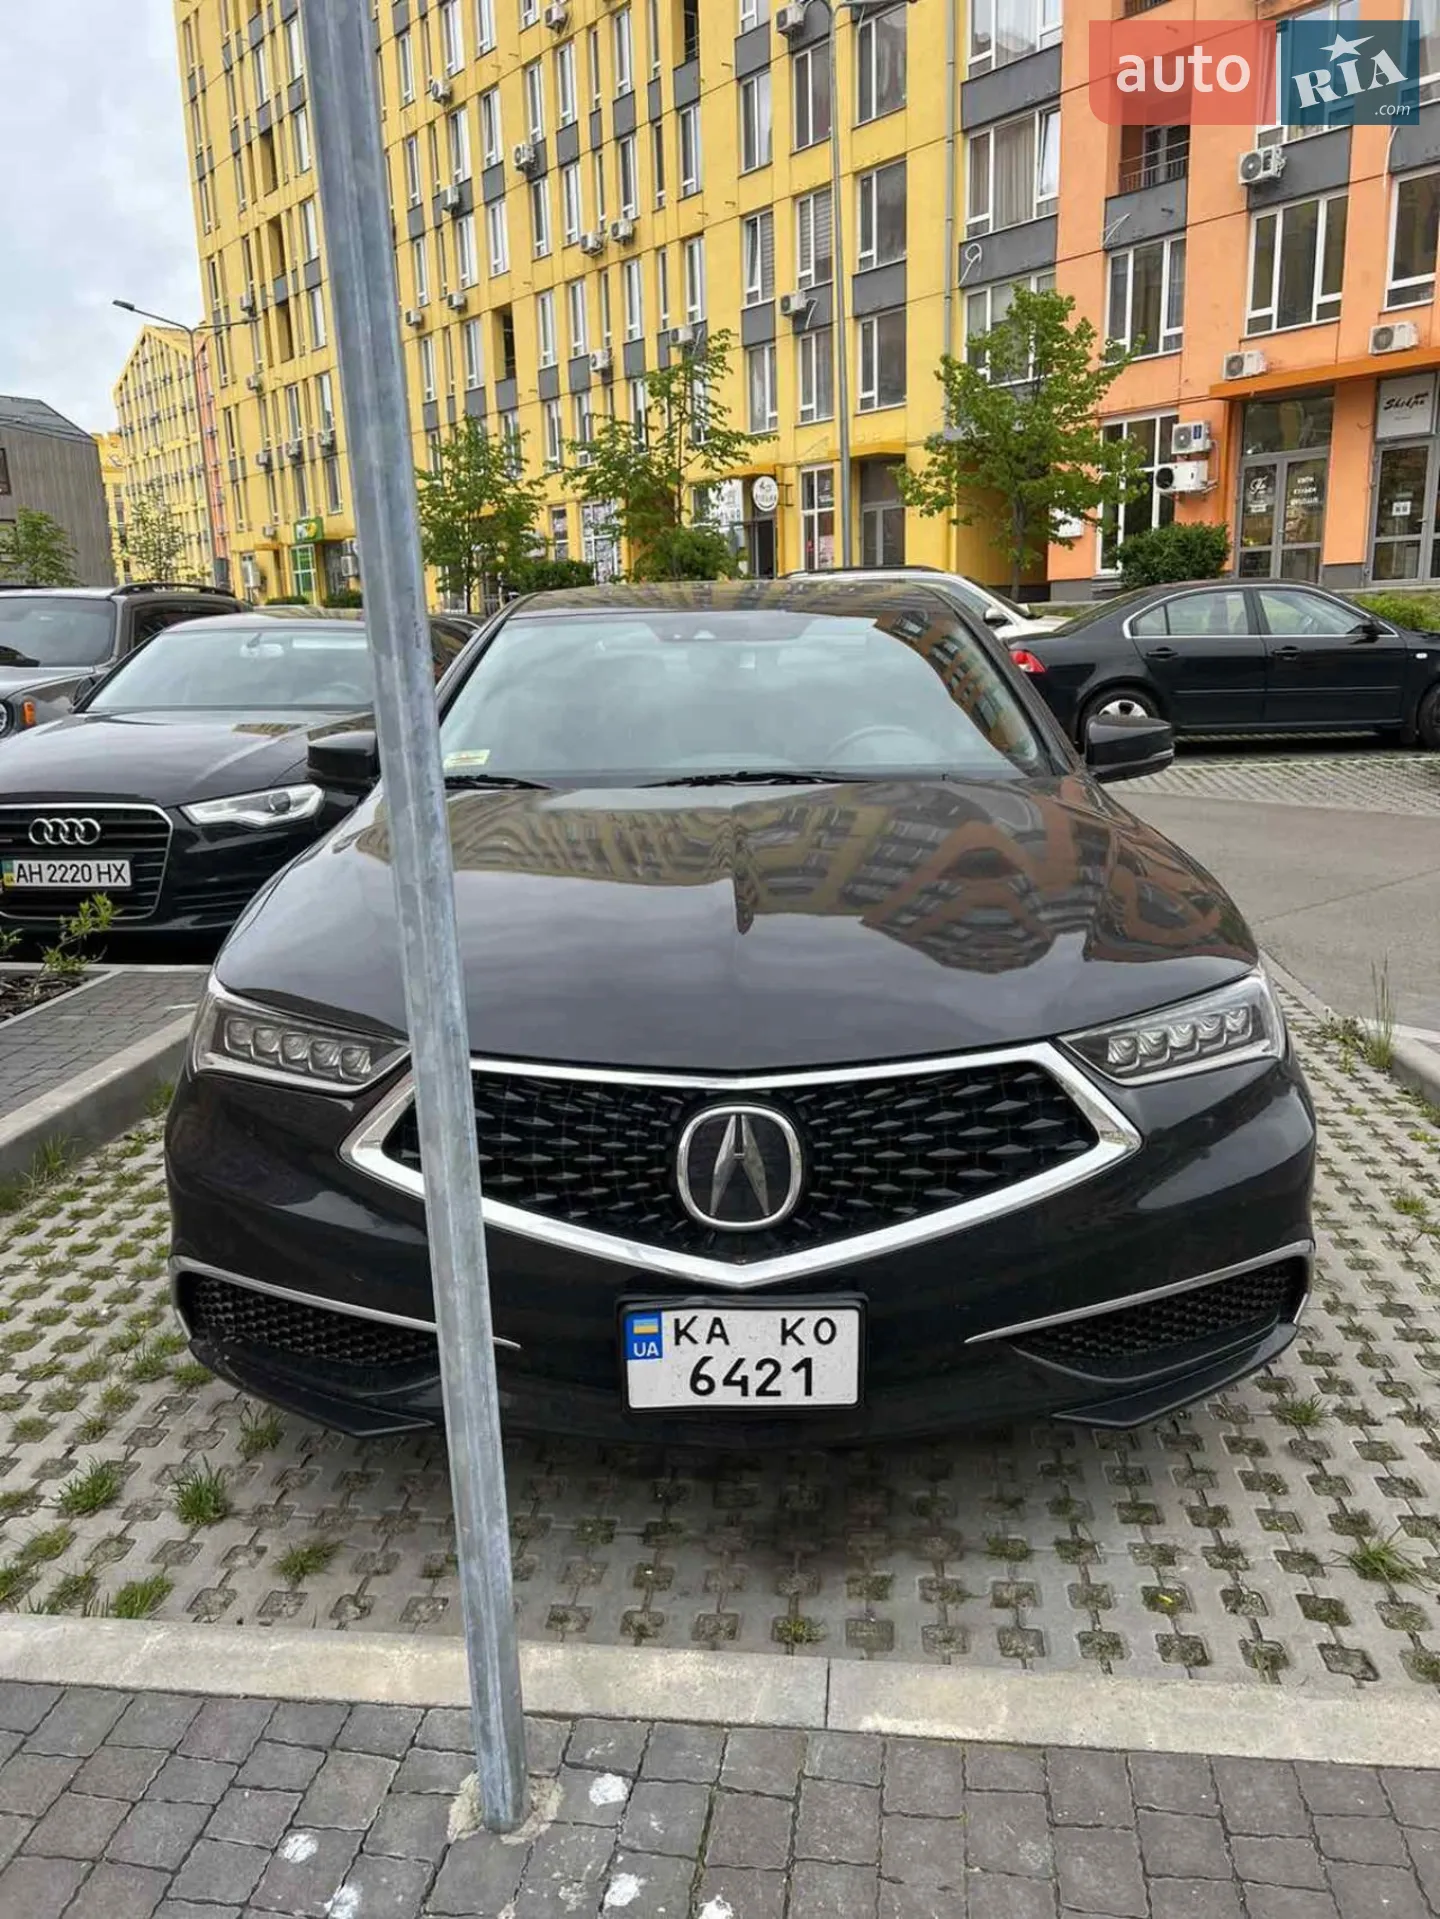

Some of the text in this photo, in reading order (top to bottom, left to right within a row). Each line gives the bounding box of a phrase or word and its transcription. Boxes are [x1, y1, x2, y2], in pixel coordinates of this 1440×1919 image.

[16, 863, 127, 883] AH 2220 HX
[674, 1316, 837, 1346] KA KO
[633, 1341, 660, 1357] UA
[689, 1355, 813, 1397] 6421
